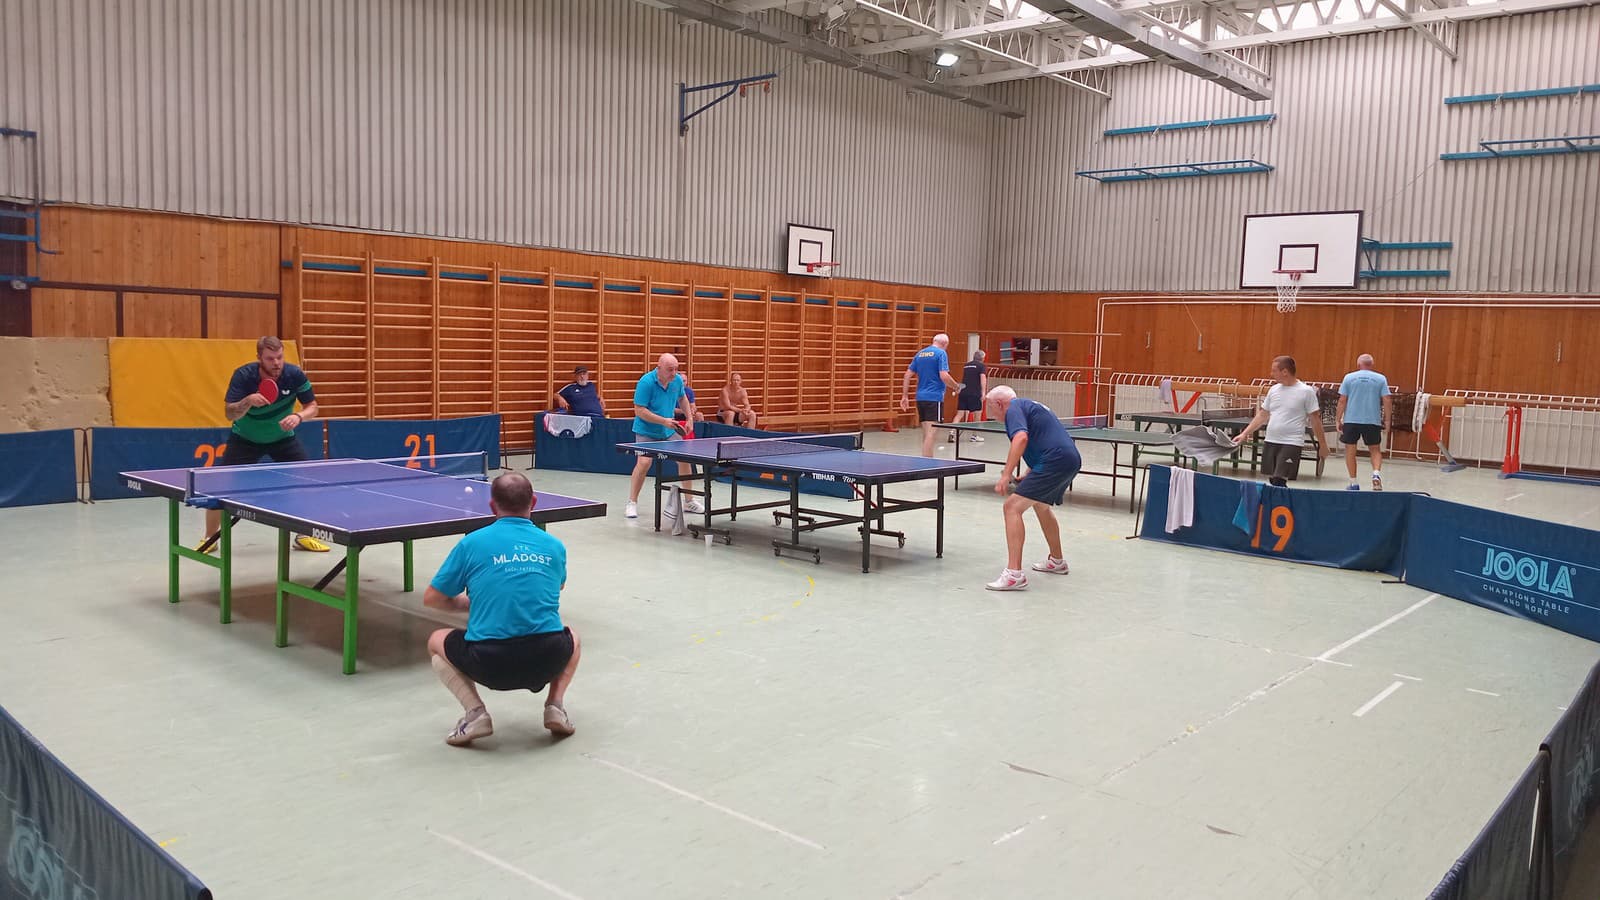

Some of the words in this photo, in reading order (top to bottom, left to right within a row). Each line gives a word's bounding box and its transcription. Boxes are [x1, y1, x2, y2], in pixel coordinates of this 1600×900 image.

[194, 444, 228, 467] 2
[404, 434, 436, 469] 21
[811, 472, 836, 482] TIBHAR
[312, 527, 334, 542] JOOLA
[493, 553, 553, 566] MLADOST
[1482, 584, 1536, 604] CHAMPIONS
[1541, 599, 1570, 614] TABLE
[1503, 597, 1521, 607] AND
[1524, 602, 1549, 616] MORE
